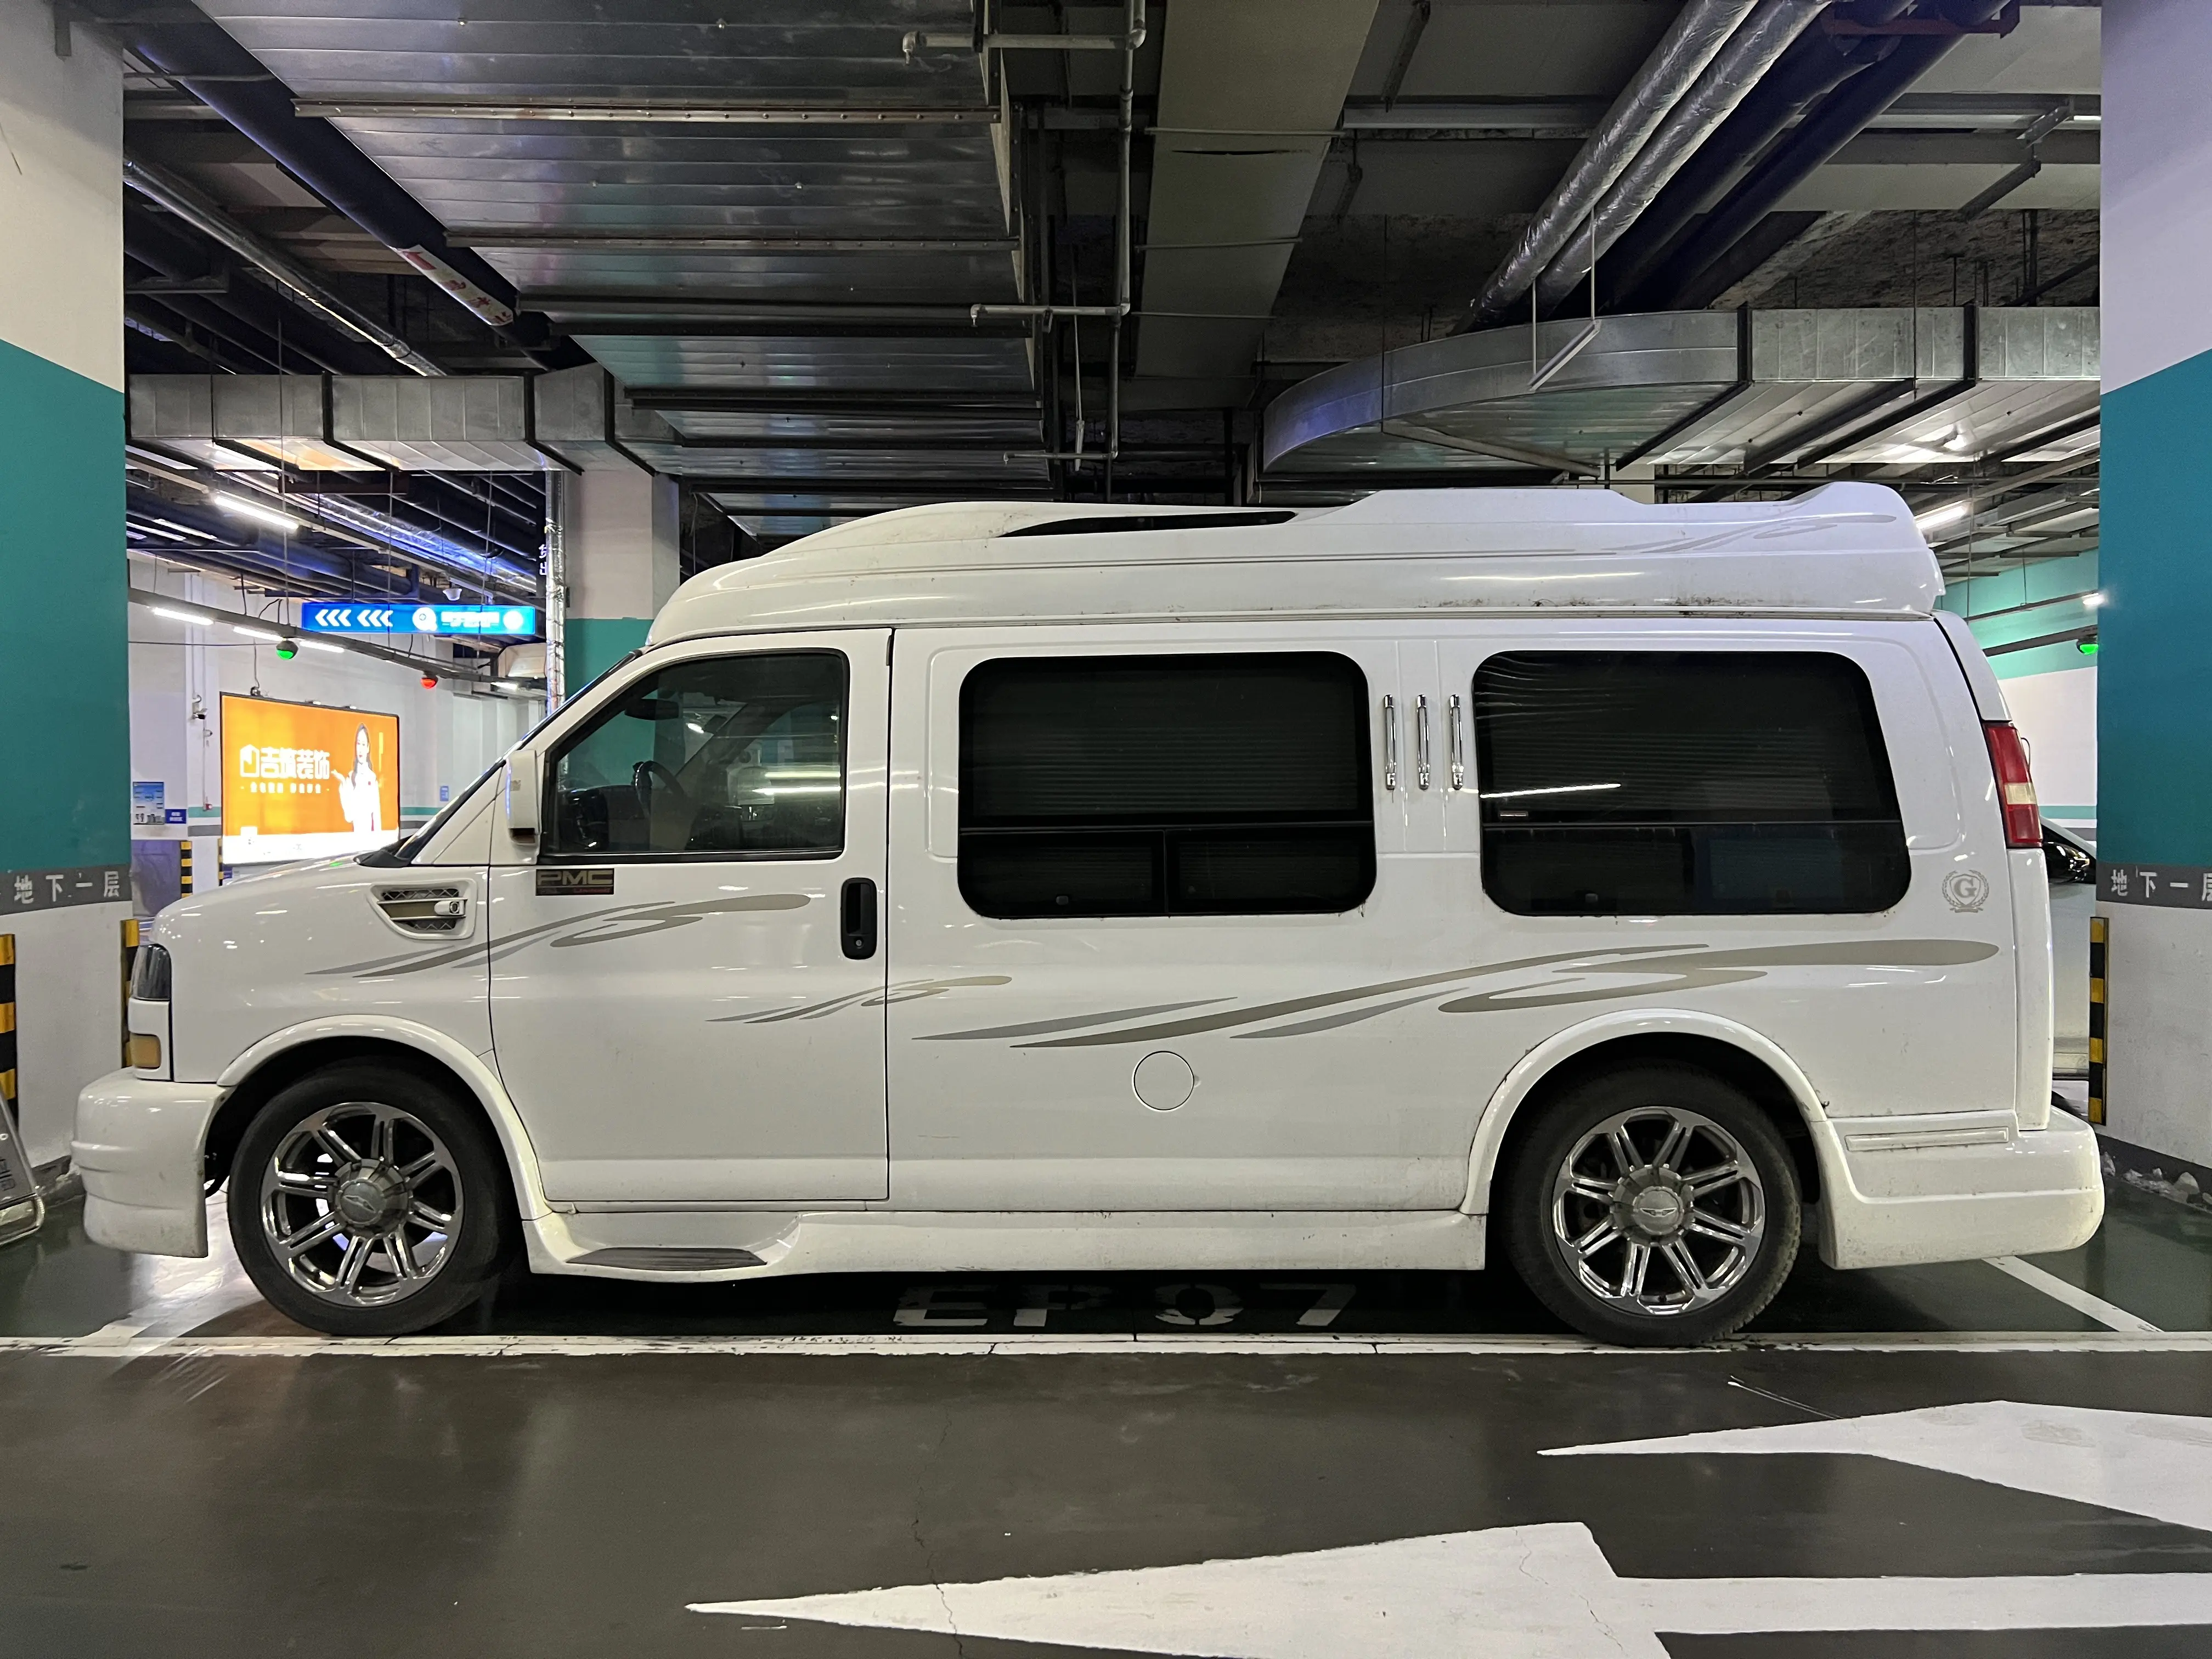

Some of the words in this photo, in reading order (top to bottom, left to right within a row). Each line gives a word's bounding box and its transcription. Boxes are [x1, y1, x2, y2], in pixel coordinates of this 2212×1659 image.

[14, 871, 120, 904] 地下一层
[1954, 878, 1977, 898] G
